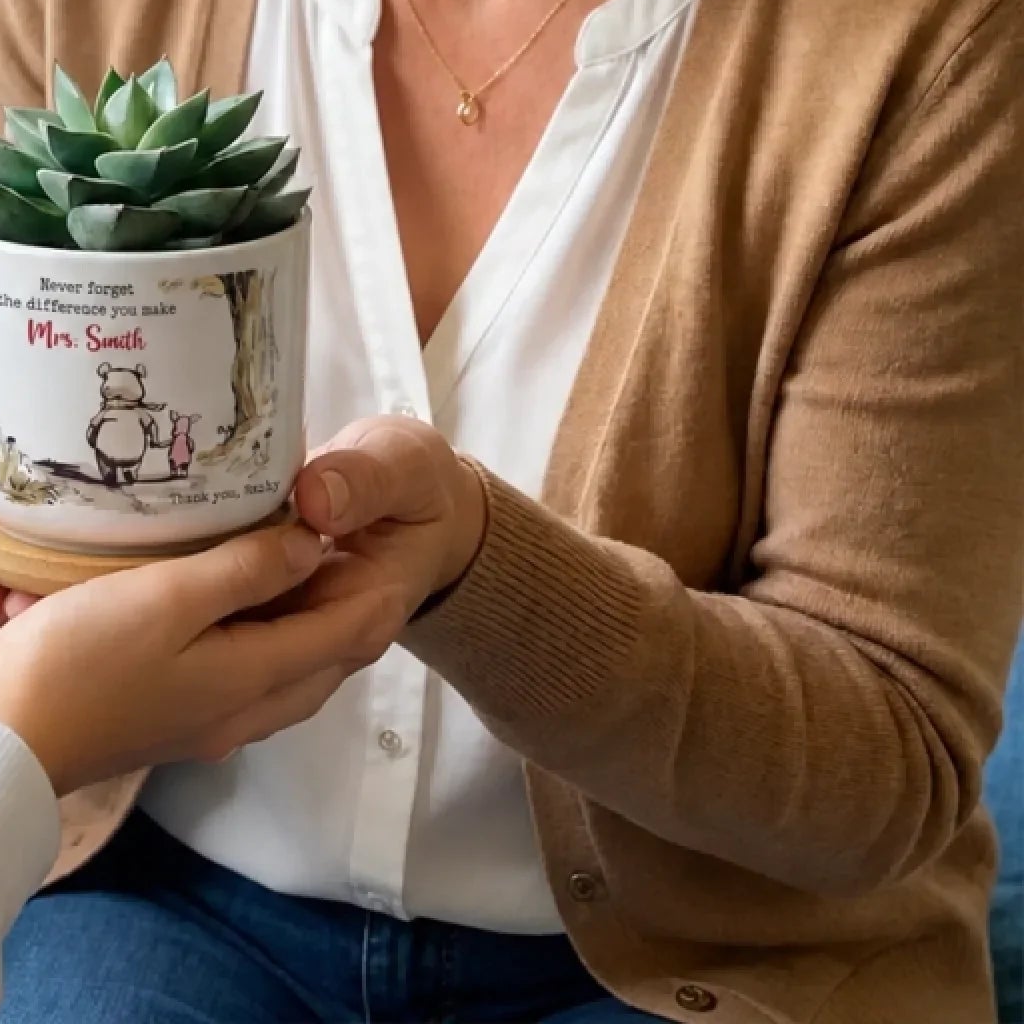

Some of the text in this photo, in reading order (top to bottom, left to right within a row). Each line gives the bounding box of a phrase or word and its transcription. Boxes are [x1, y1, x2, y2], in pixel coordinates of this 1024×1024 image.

[39, 277, 135, 298] Never forget
[25, 295, 107, 317] difference
[110, 304, 137, 319] you
[141, 302, 177, 317] make
[28, 319, 148, 352] Mrs. Smith
[169, 489, 209, 505] Thank
